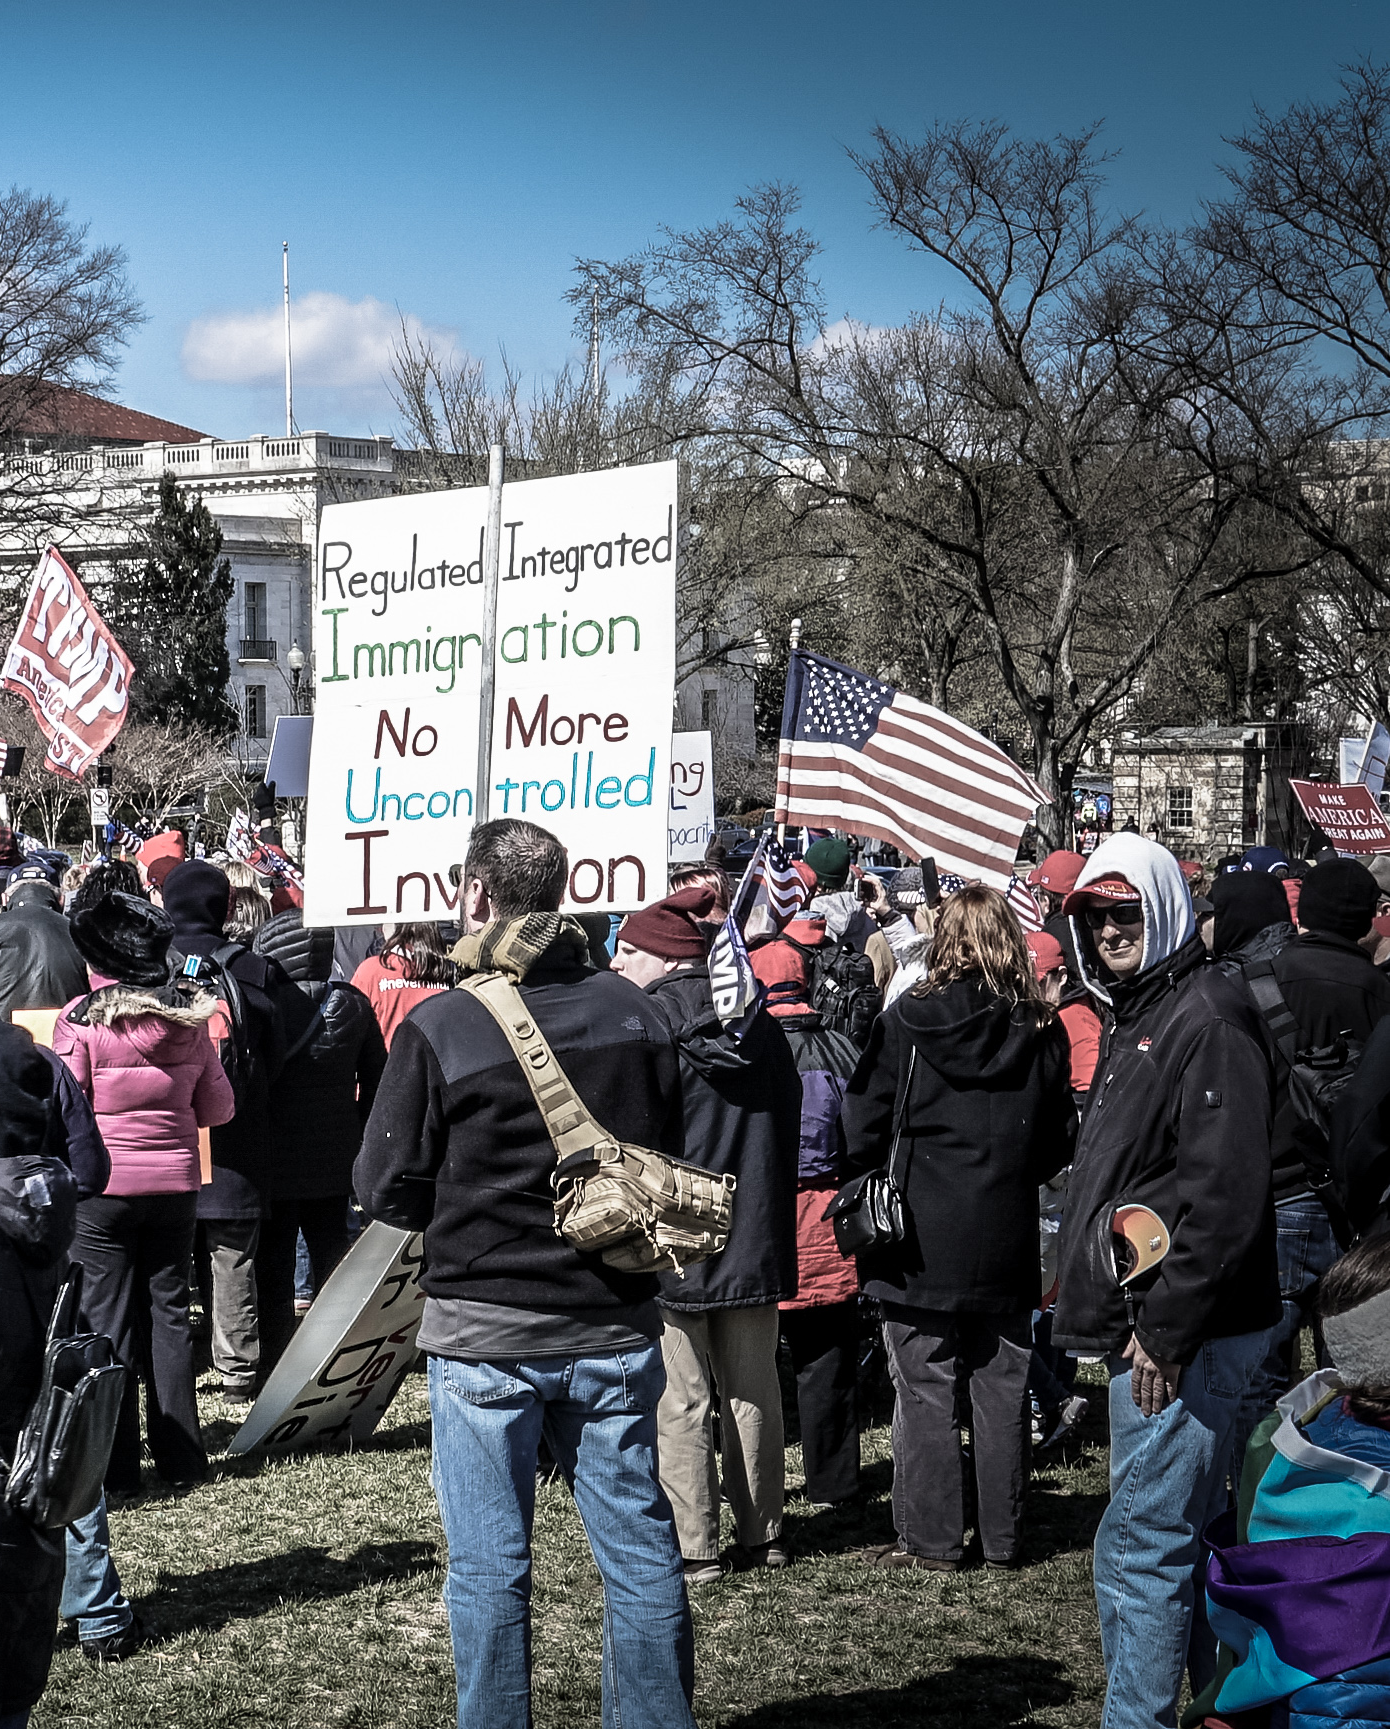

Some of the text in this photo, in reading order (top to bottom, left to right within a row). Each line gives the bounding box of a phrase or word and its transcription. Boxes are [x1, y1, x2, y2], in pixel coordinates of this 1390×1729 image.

[323, 504, 673, 616] Regulated Integrated
[374, 694, 628, 759] No More
[1307, 806, 1384, 827] AMERICA
[1318, 794, 1348, 807] MAKE
[1350, 828, 1386, 841] AGAIN
[345, 830, 646, 915] Invon
[263, 1335, 388, 1446] Die
